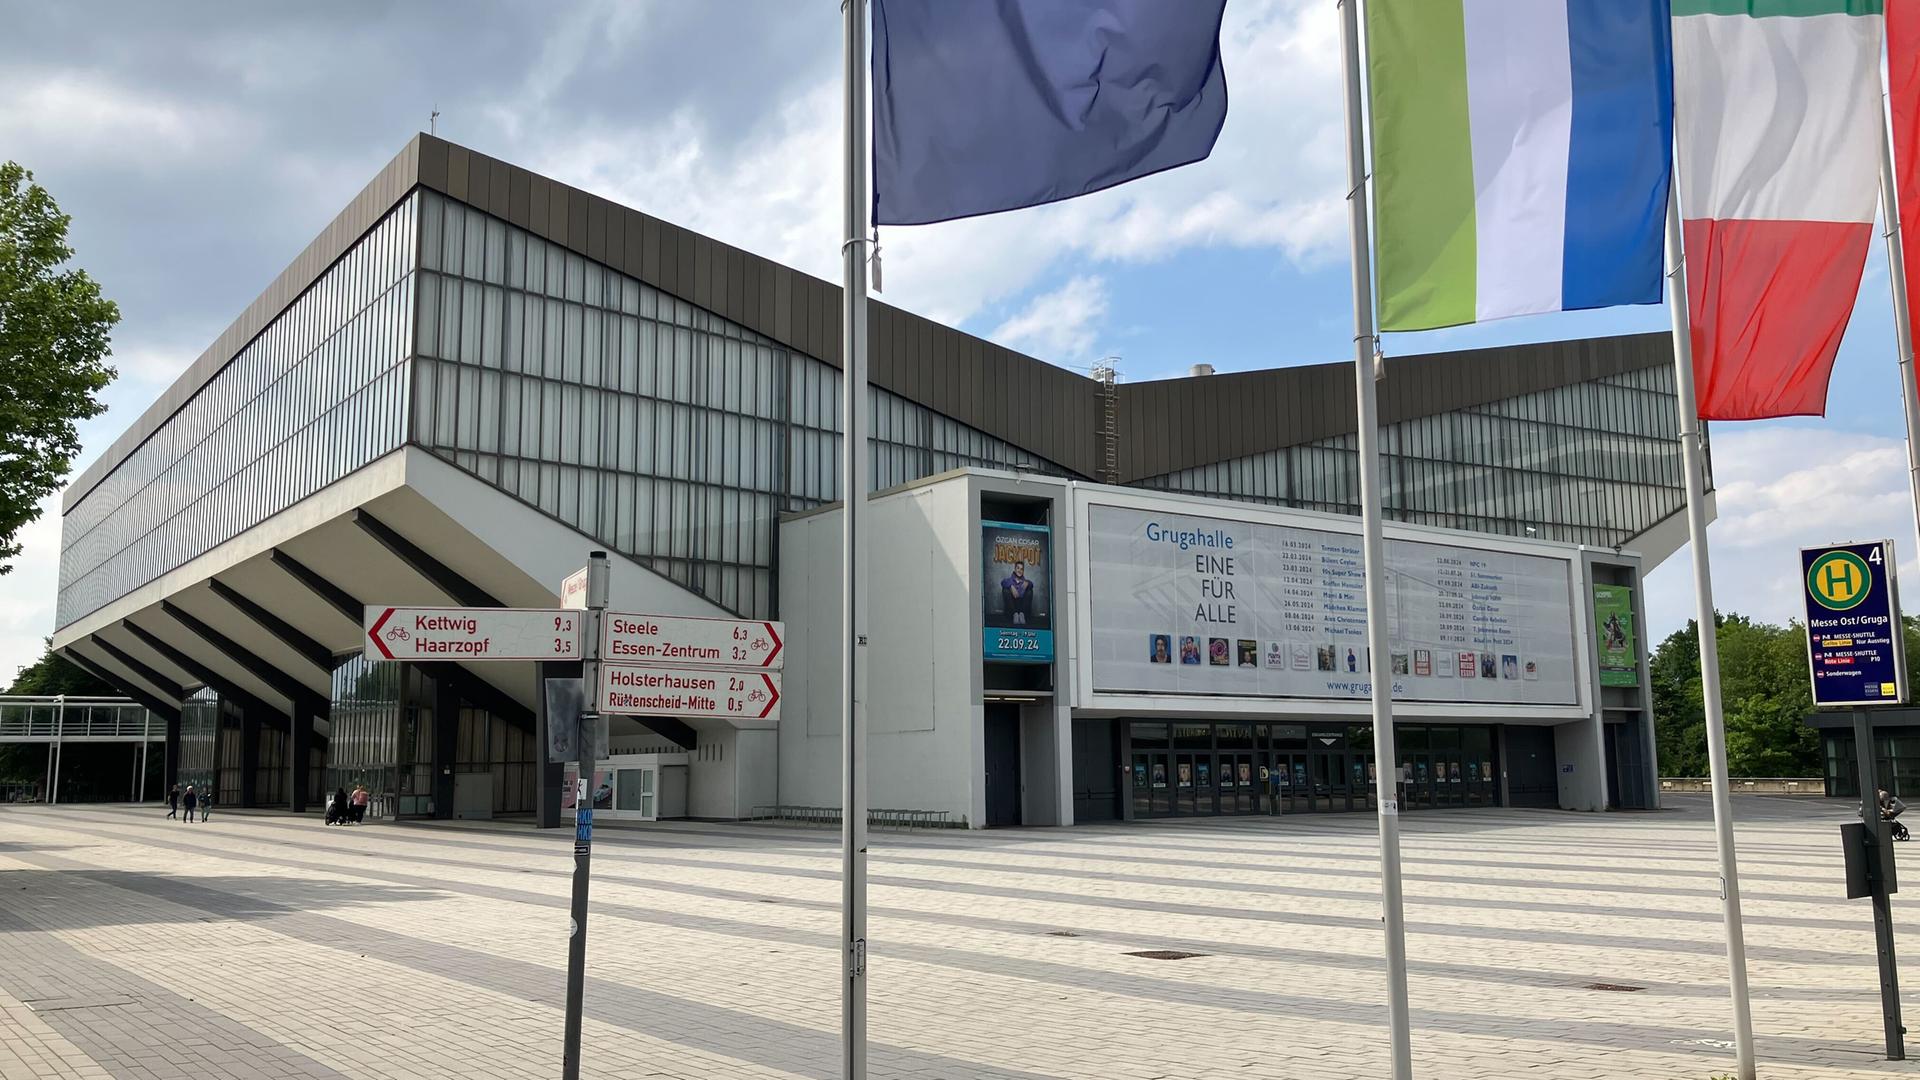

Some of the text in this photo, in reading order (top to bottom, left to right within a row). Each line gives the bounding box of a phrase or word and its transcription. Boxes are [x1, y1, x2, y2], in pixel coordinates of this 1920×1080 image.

[1146, 523, 1234, 550] Grugahalle
[993, 544, 1041, 567] JACKPOT
[1196, 554, 1234, 576] EINE
[1868, 547, 1882, 565] 4
[1202, 577, 1236, 600] FÜR
[1825, 563, 1853, 597] H
[1195, 603, 1236, 624] ALLE
[1810, 618, 1838, 628] Messe
[415, 614, 572, 635] Kettwig 9,3
[613, 619, 748, 641] Steele 6,3
[998, 638, 1039, 650] 22.09.24
[1833, 631, 1875, 640] MESSE-SHUTTLE
[415, 637, 571, 656] Haarzopf 3,5
[612, 640, 747, 661] Essen-Zentrum 3,2
[1835, 650, 1877, 658] MESSE-SHUTTLE
[610, 671, 744, 692] Holsterhausen 2,0
[609, 692, 742, 711] Rüttenscheid-Mitte 0,5
